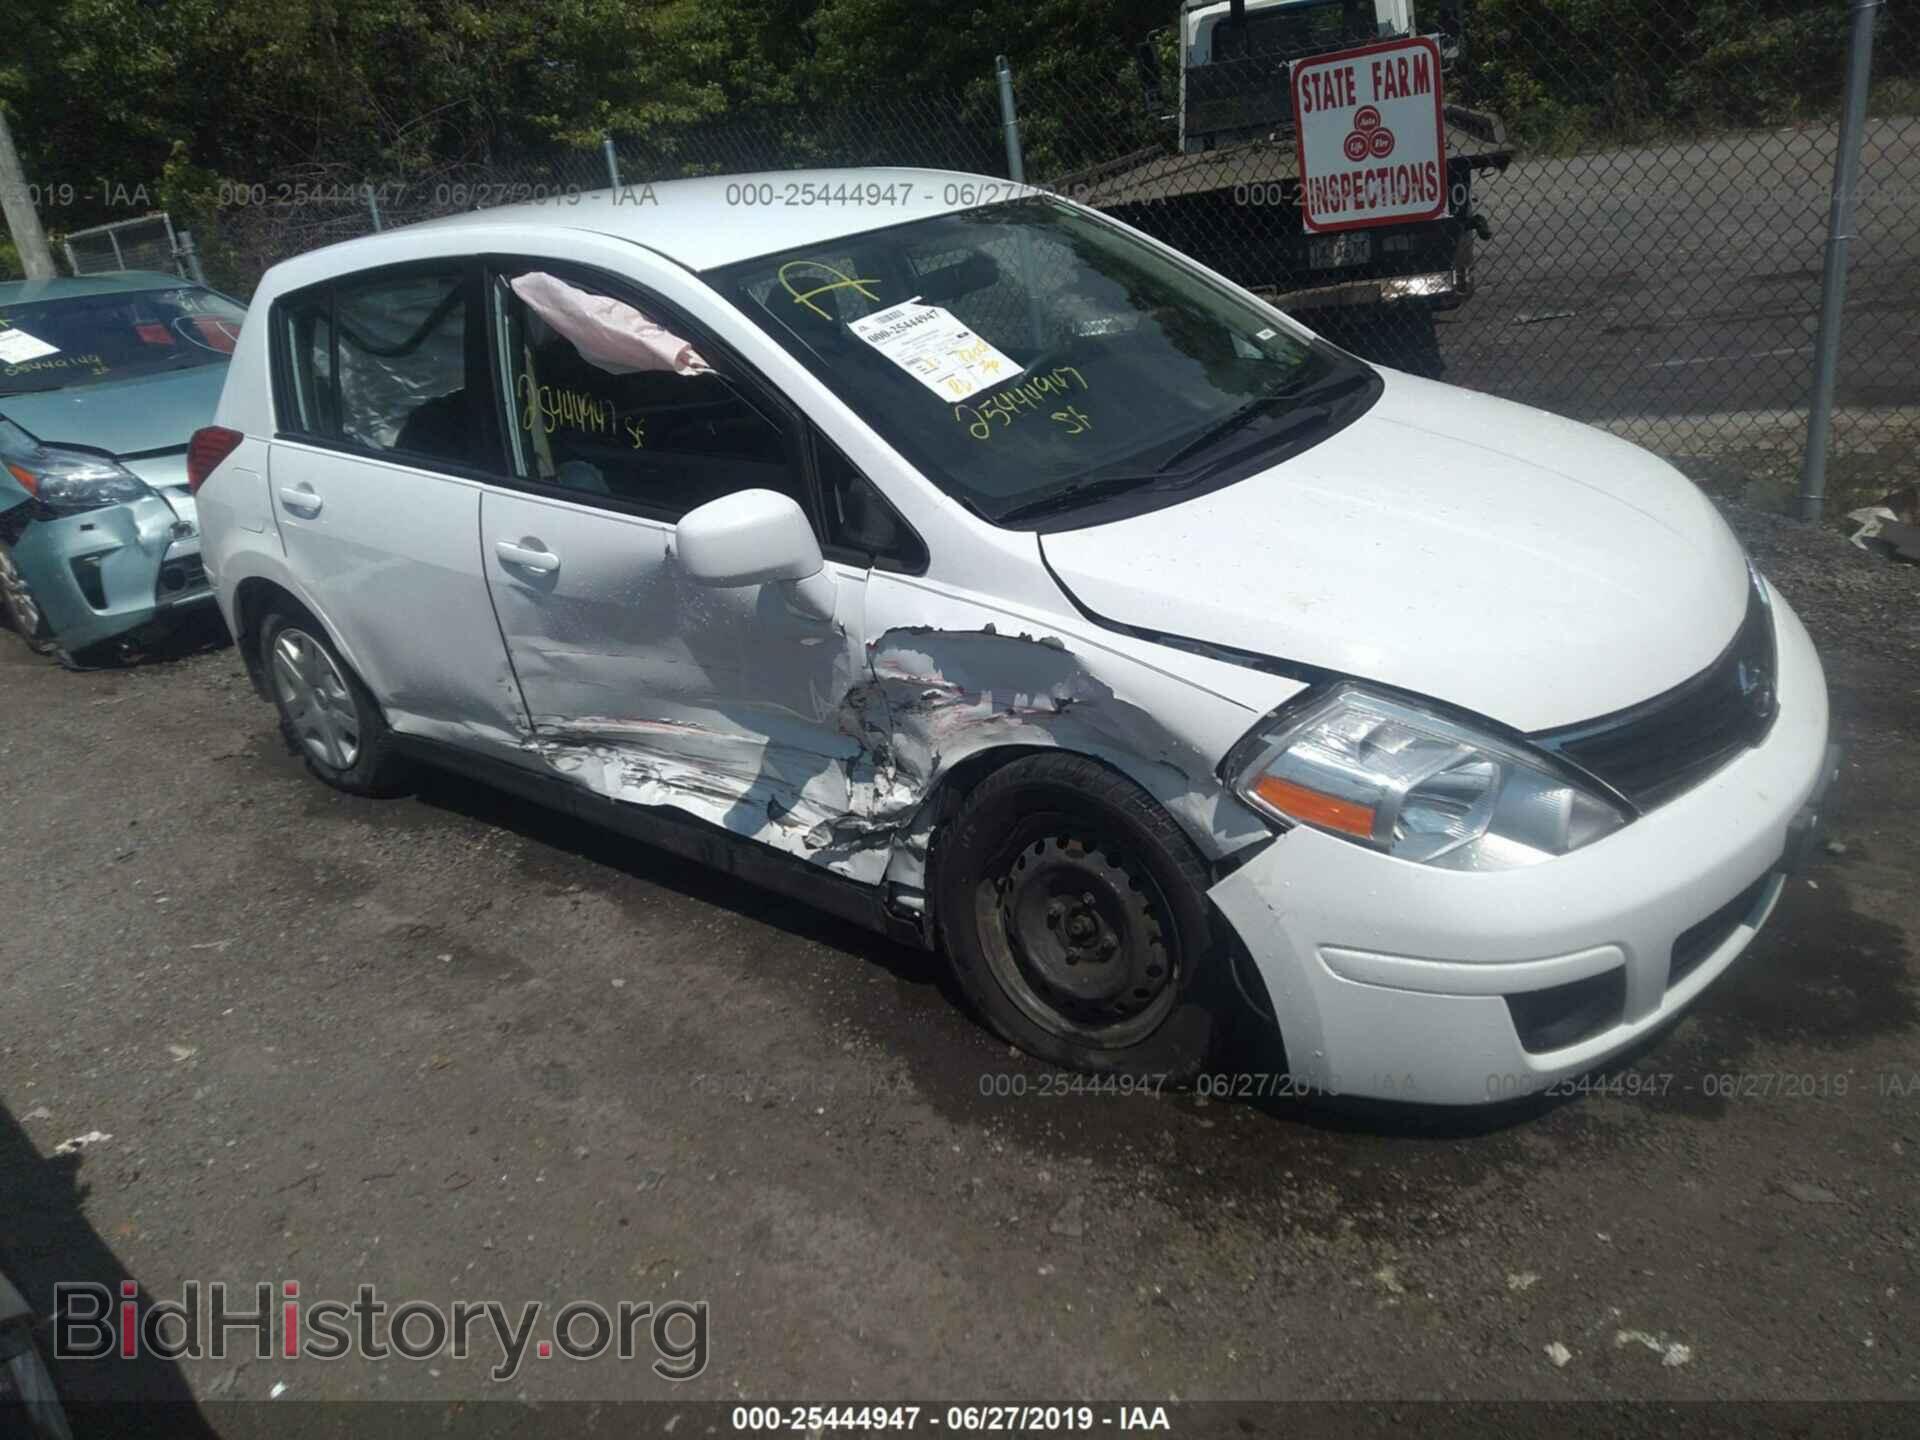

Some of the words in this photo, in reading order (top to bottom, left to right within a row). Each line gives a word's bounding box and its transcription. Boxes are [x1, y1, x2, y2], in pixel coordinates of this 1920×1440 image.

[1302, 66, 1357, 114] STATE
[1371, 53, 1431, 102] FARM
[1307, 160, 1438, 216] INSPECTIONS
